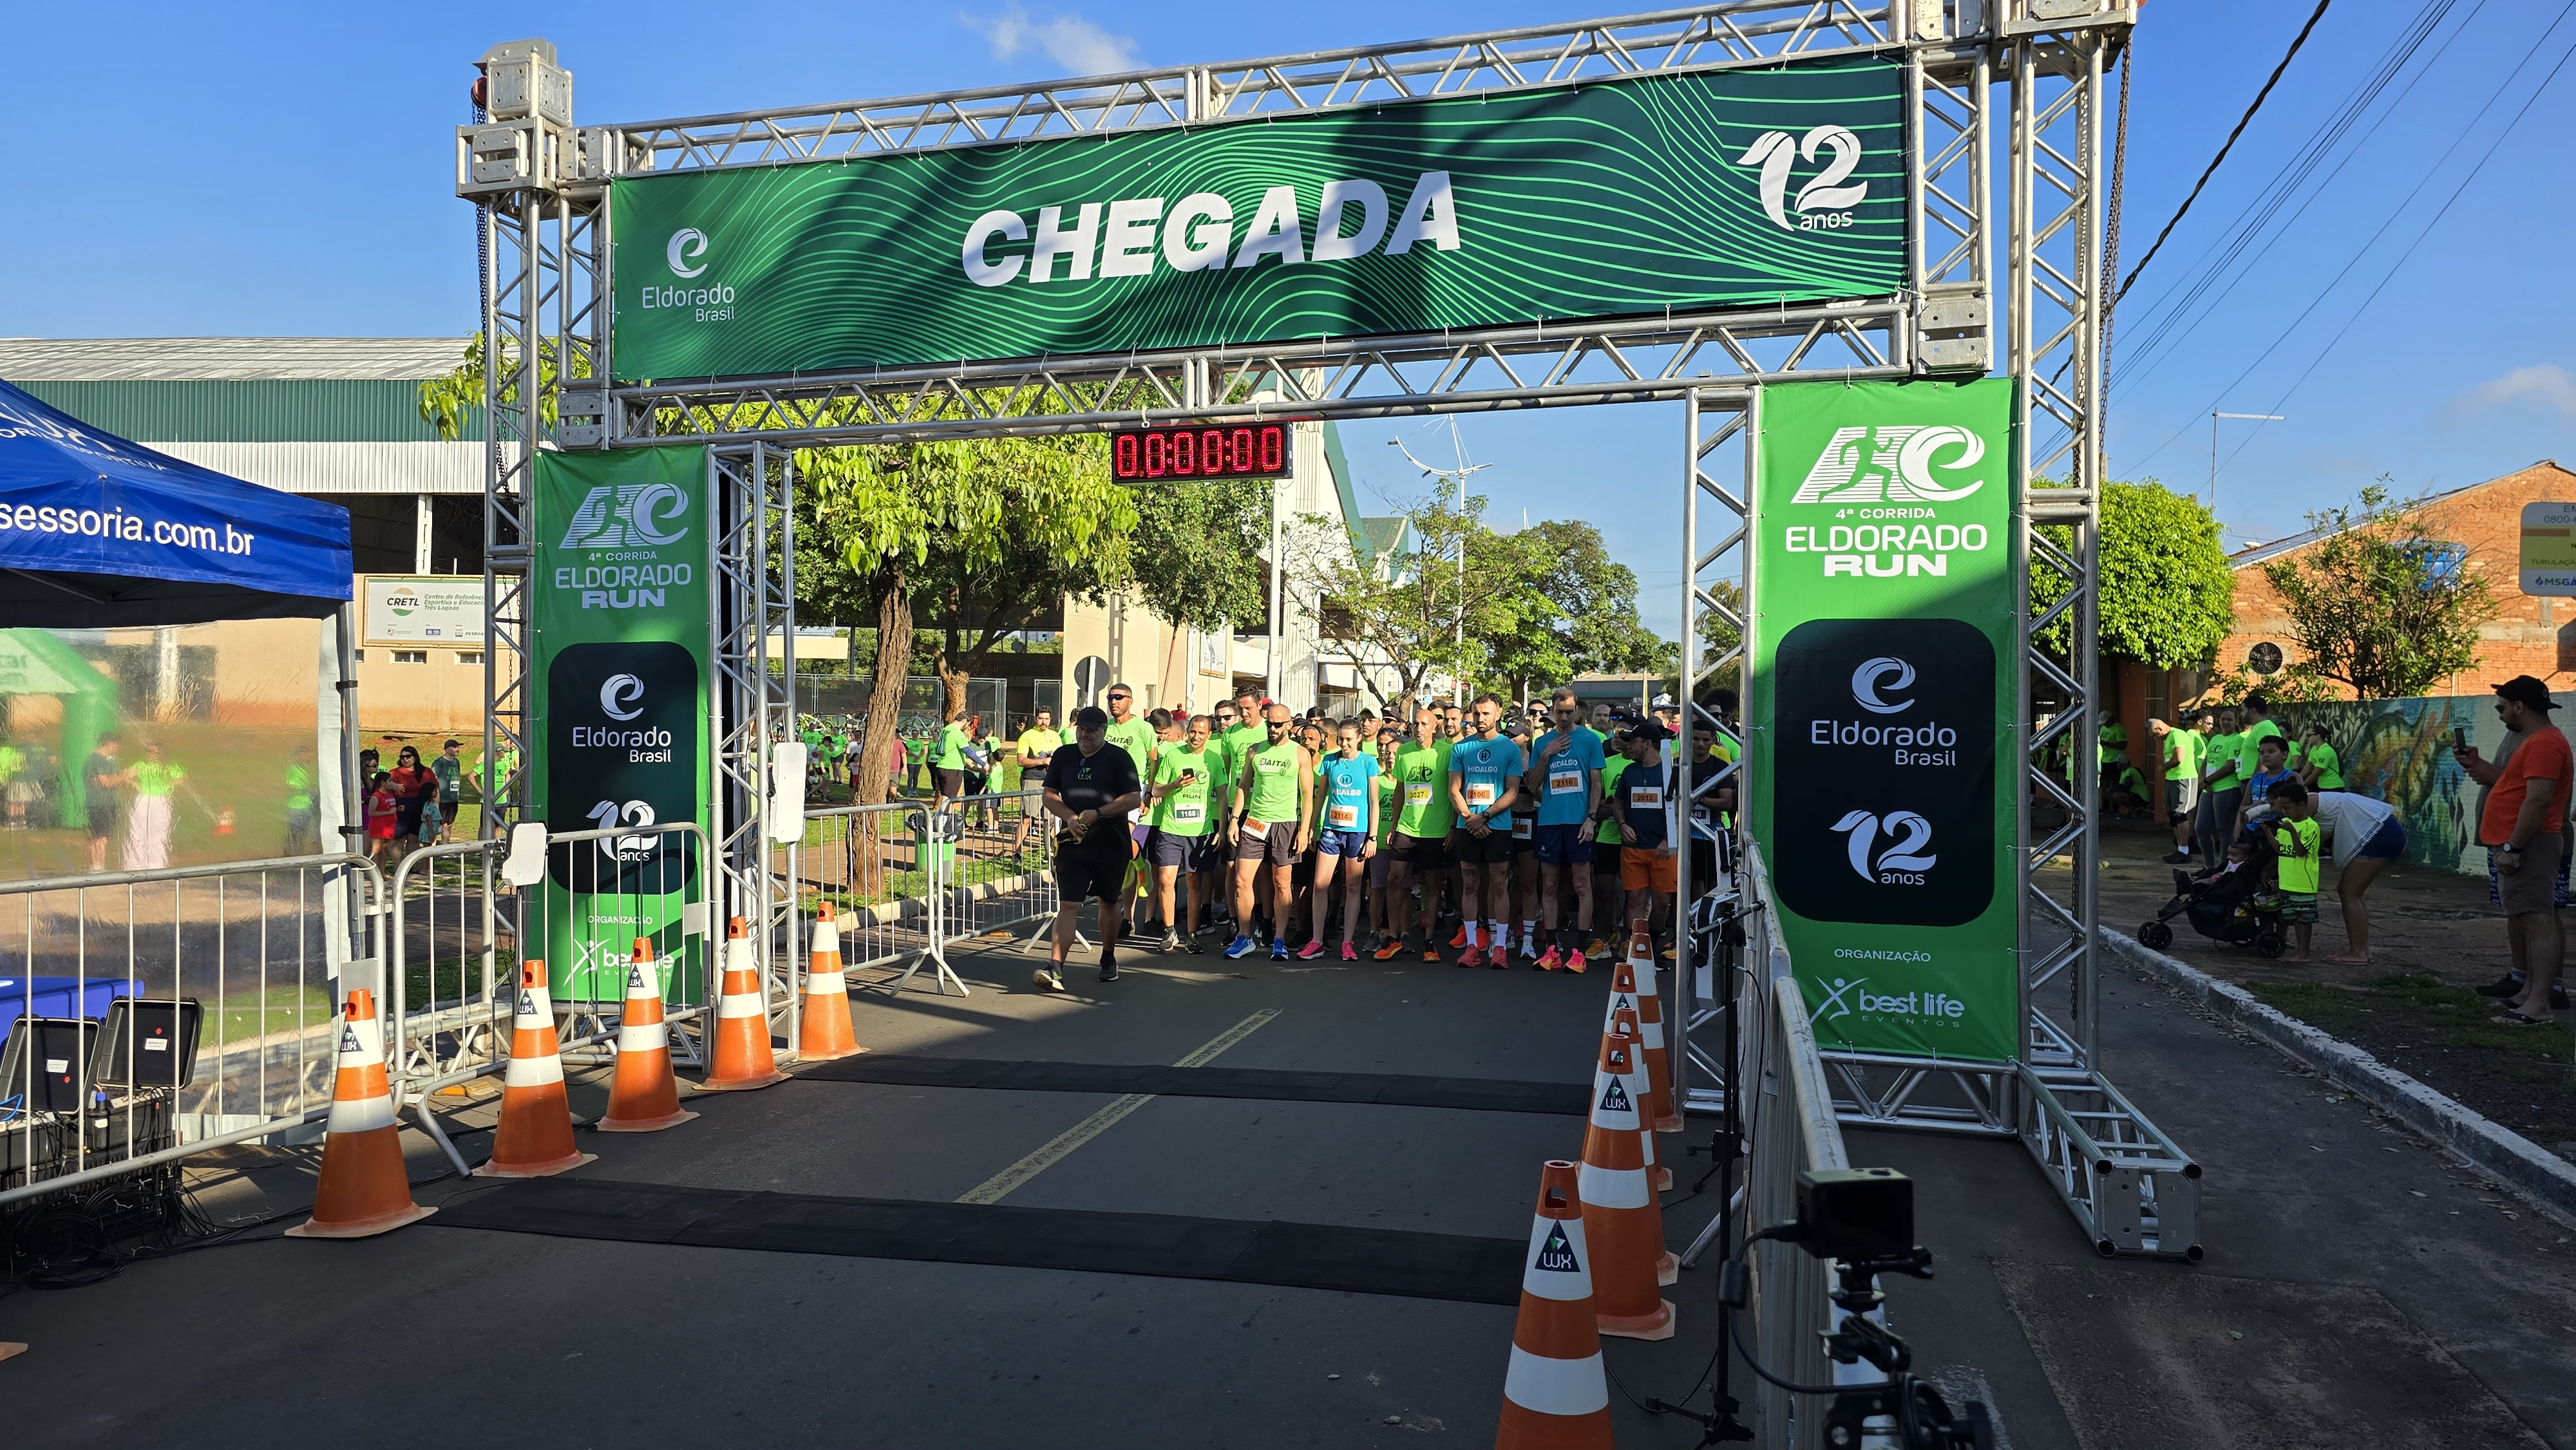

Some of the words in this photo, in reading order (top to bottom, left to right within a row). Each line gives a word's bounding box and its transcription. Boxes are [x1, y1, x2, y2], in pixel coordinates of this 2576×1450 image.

[1736, 125, 1868, 231] 12
[963, 171, 1461, 287] CHEGADA
[1800, 212, 1853, 231] anos
[642, 281, 735, 310] Eldorado
[696, 305, 735, 323] Brasil
[1117, 426, 1282, 477] 00:00:00
[1860, 508, 1935, 519] CORRIDA
[1786, 524, 1987, 552] ELDORADO
[606, 551, 657, 561] CORRIDA
[1824, 554, 1946, 577] RUN
[556, 563, 691, 588] ELDORADO
[387, 598, 420, 607] CRETL
[582, 588, 665, 609] RUN
[573, 726, 672, 748] Eldorado
[1812, 720, 1956, 747] Eldorado
[629, 749, 671, 763] Brasil
[1549, 759, 1578, 770] HIDALGO
[1895, 749, 1956, 766] Brasil
[1557, 778, 1573, 787] 2116
[1247, 820, 1262, 831] 2169
[1830, 810, 1937, 883] 12
[1881, 872, 1925, 885] anos
[603, 948, 632, 968] bes
[1834, 948, 1931, 964] ORGANIZAÇÃO
[518, 1004, 533, 1013] WX
[1859, 989, 1918, 1015] best
[1924, 993, 1965, 1019] life
[1862, 1016, 1960, 1028] EVENTOS
[341, 1042, 357, 1051] WX
[1605, 1098, 1625, 1109] WX
[1543, 1252, 1571, 1269] WX
